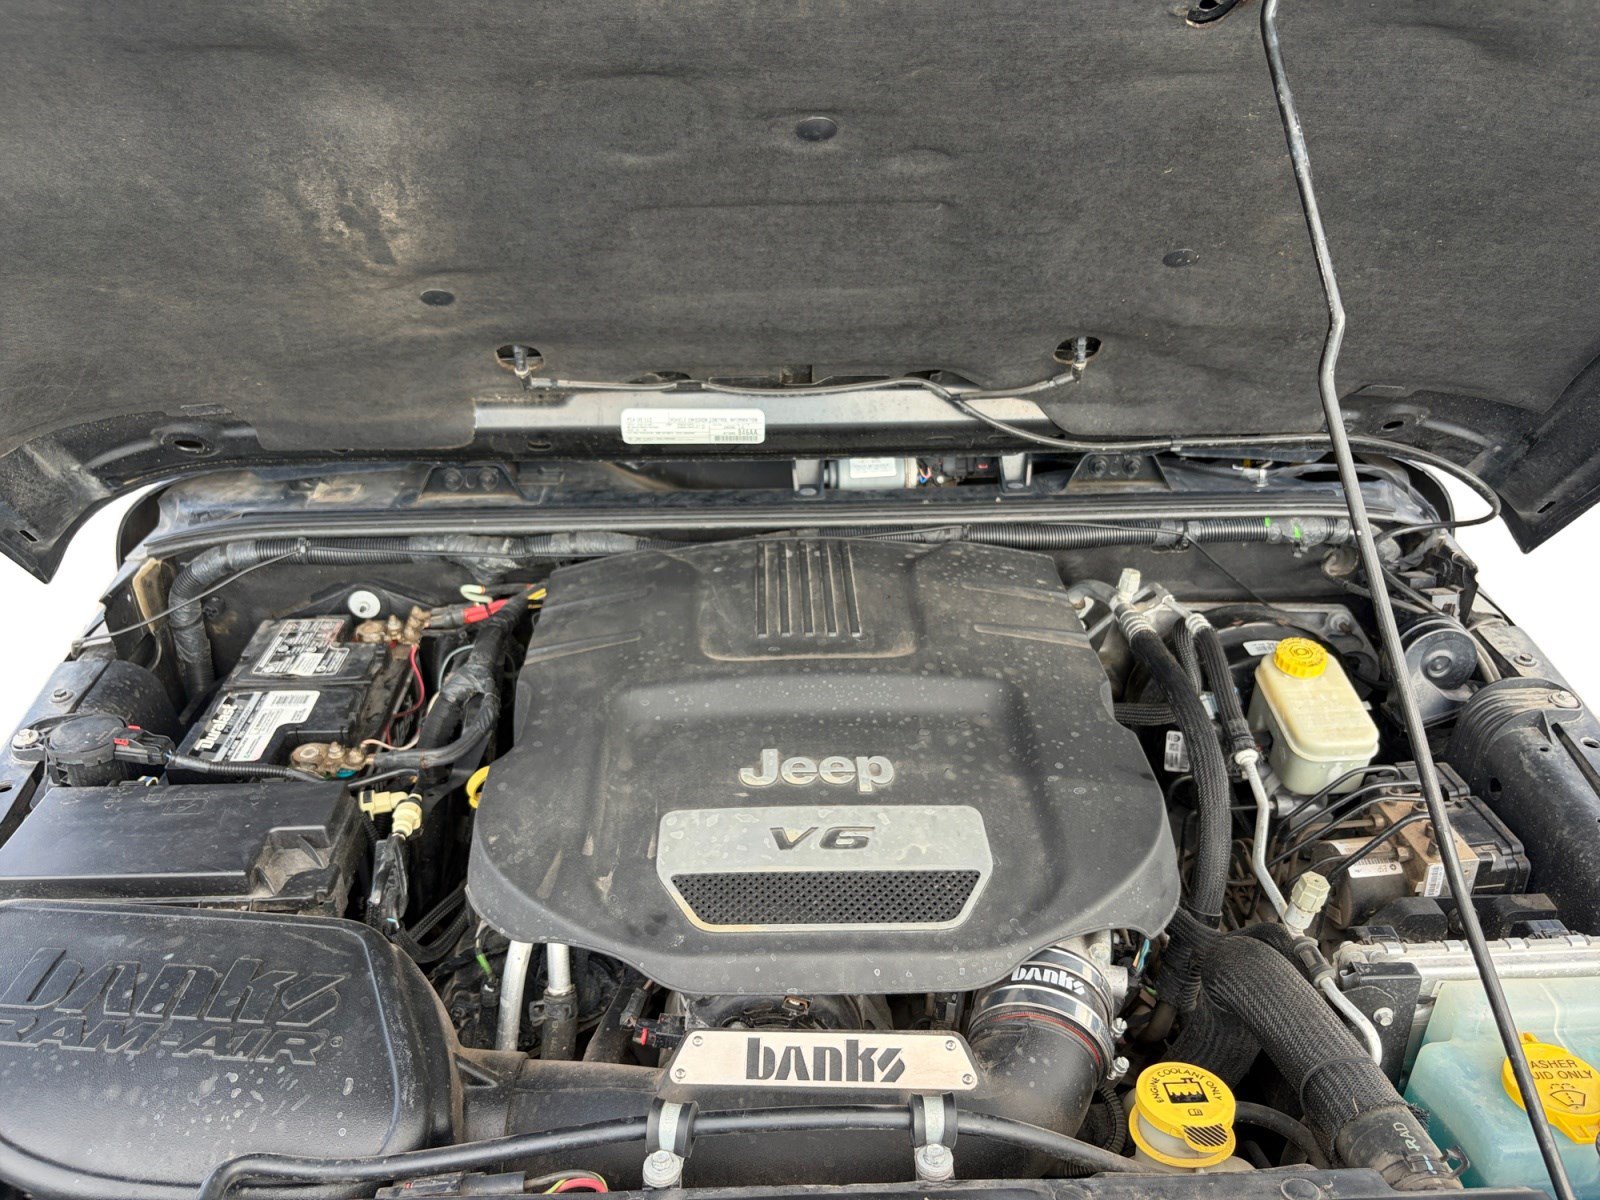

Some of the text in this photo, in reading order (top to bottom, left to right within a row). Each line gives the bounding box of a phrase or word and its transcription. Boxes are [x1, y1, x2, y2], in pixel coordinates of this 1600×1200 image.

[193, 703, 239, 751] Duralast
[739, 748, 895, 793] Jeep
[769, 826, 875, 850] V6
[0, 947, 346, 1027] banks
[1010, 967, 1086, 996] banks
[746, 1037, 906, 1083] banks
[1530, 1059, 1578, 1069] ASHER
[1557, 1070, 1593, 1079] ONLY
[1150, 1067, 1223, 1104] ENGINE COOLANT ONLY
[1393, 1122, 1421, 1152] RAD
